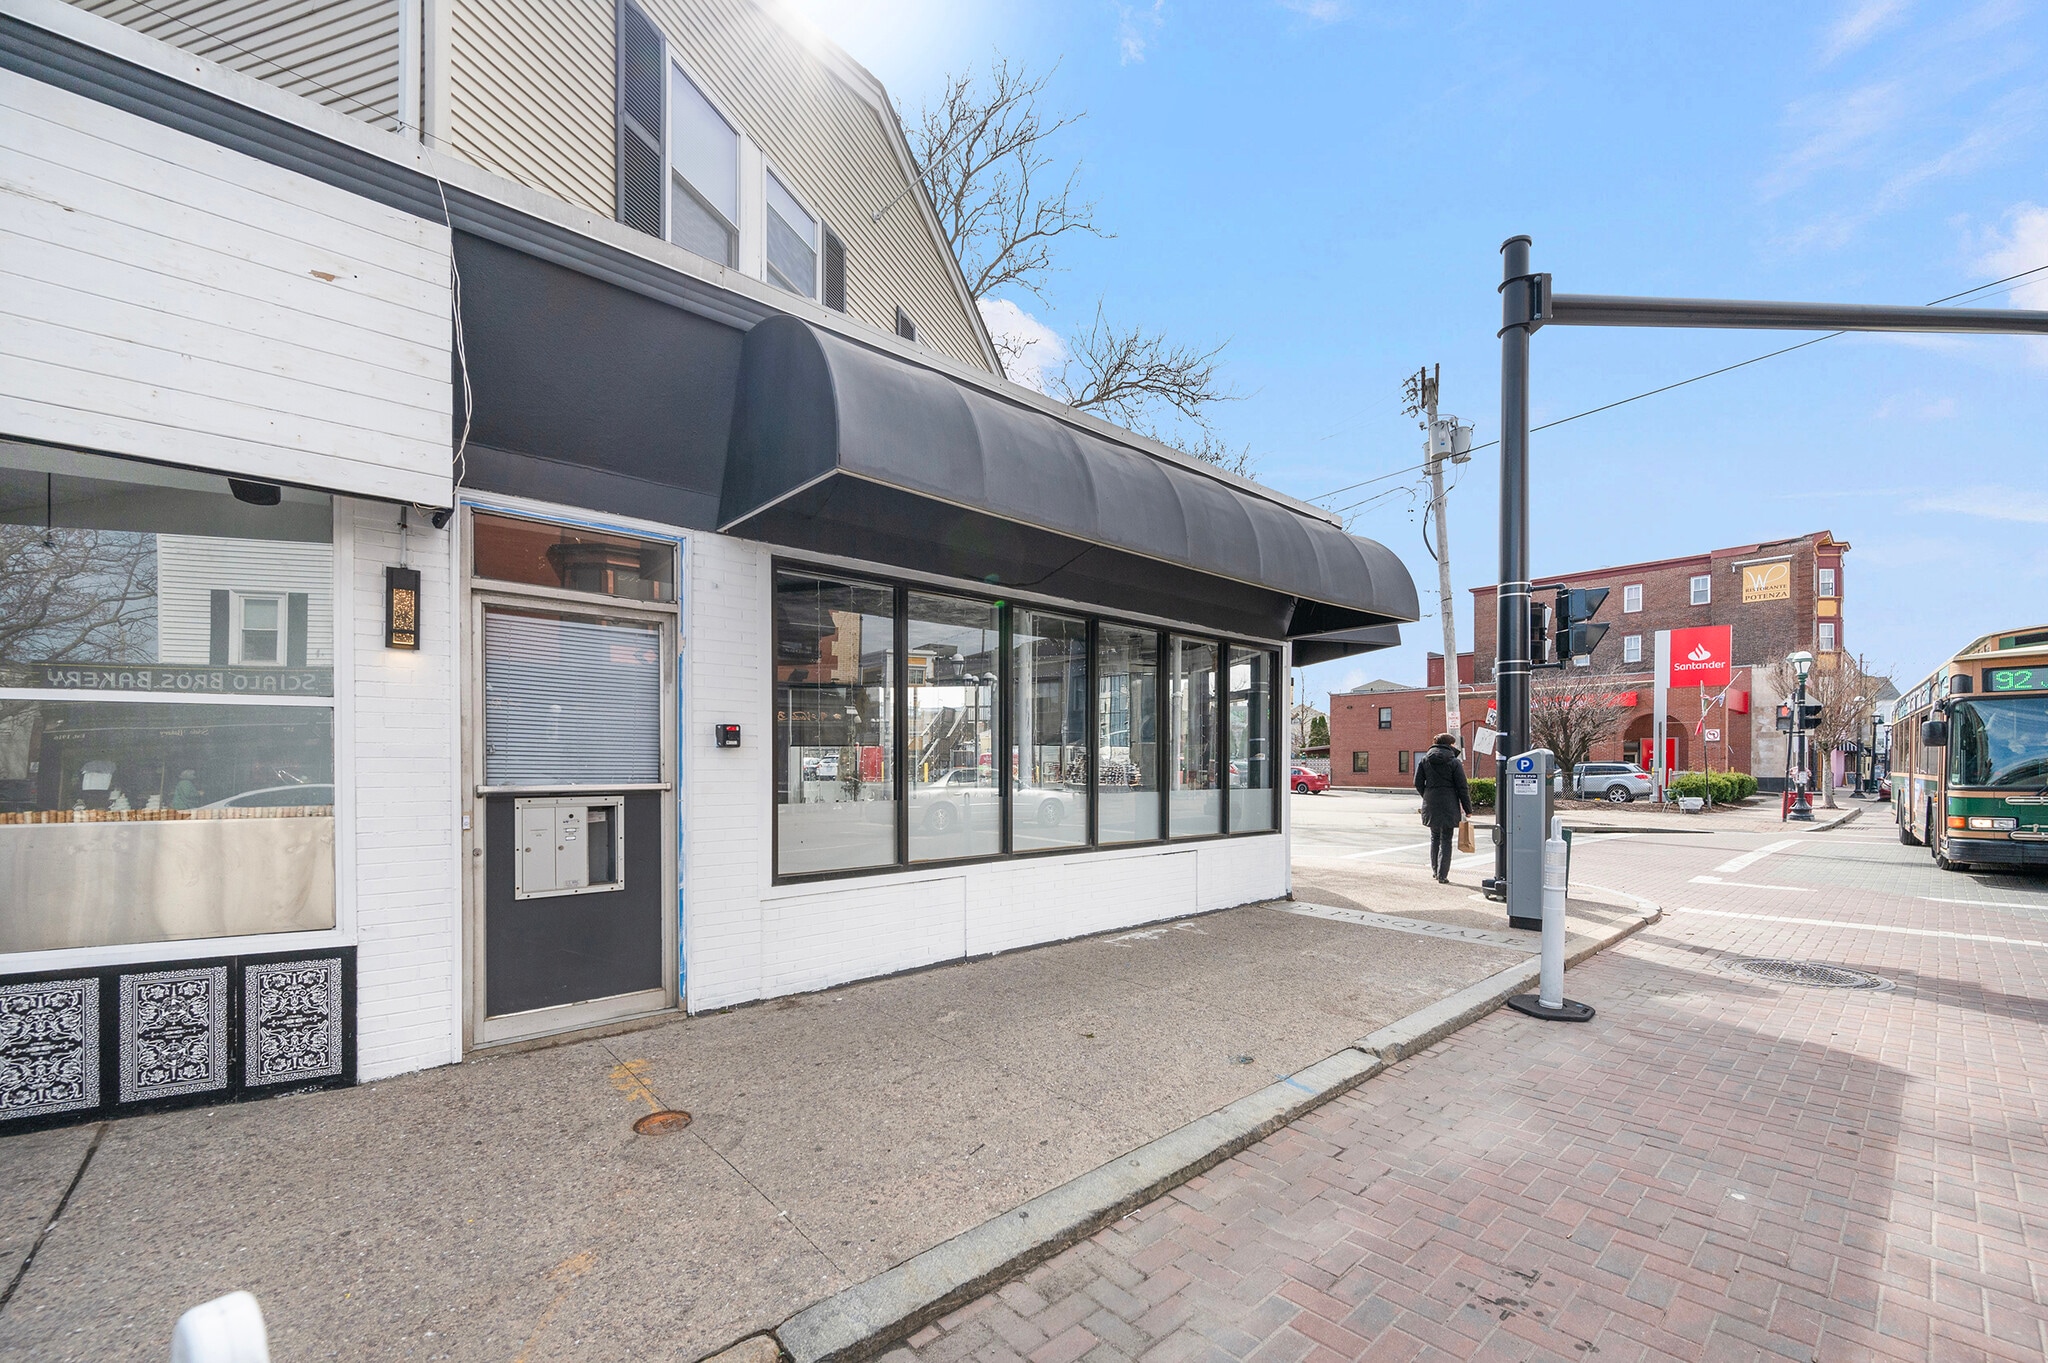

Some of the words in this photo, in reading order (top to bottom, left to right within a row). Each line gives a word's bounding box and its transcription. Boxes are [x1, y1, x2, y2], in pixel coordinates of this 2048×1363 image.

[1745, 592, 1788, 601] POTENZA
[1674, 661, 1726, 671] Santander
[1995, 670, 2033, 690] 92
[1520, 759, 1530, 770] P
